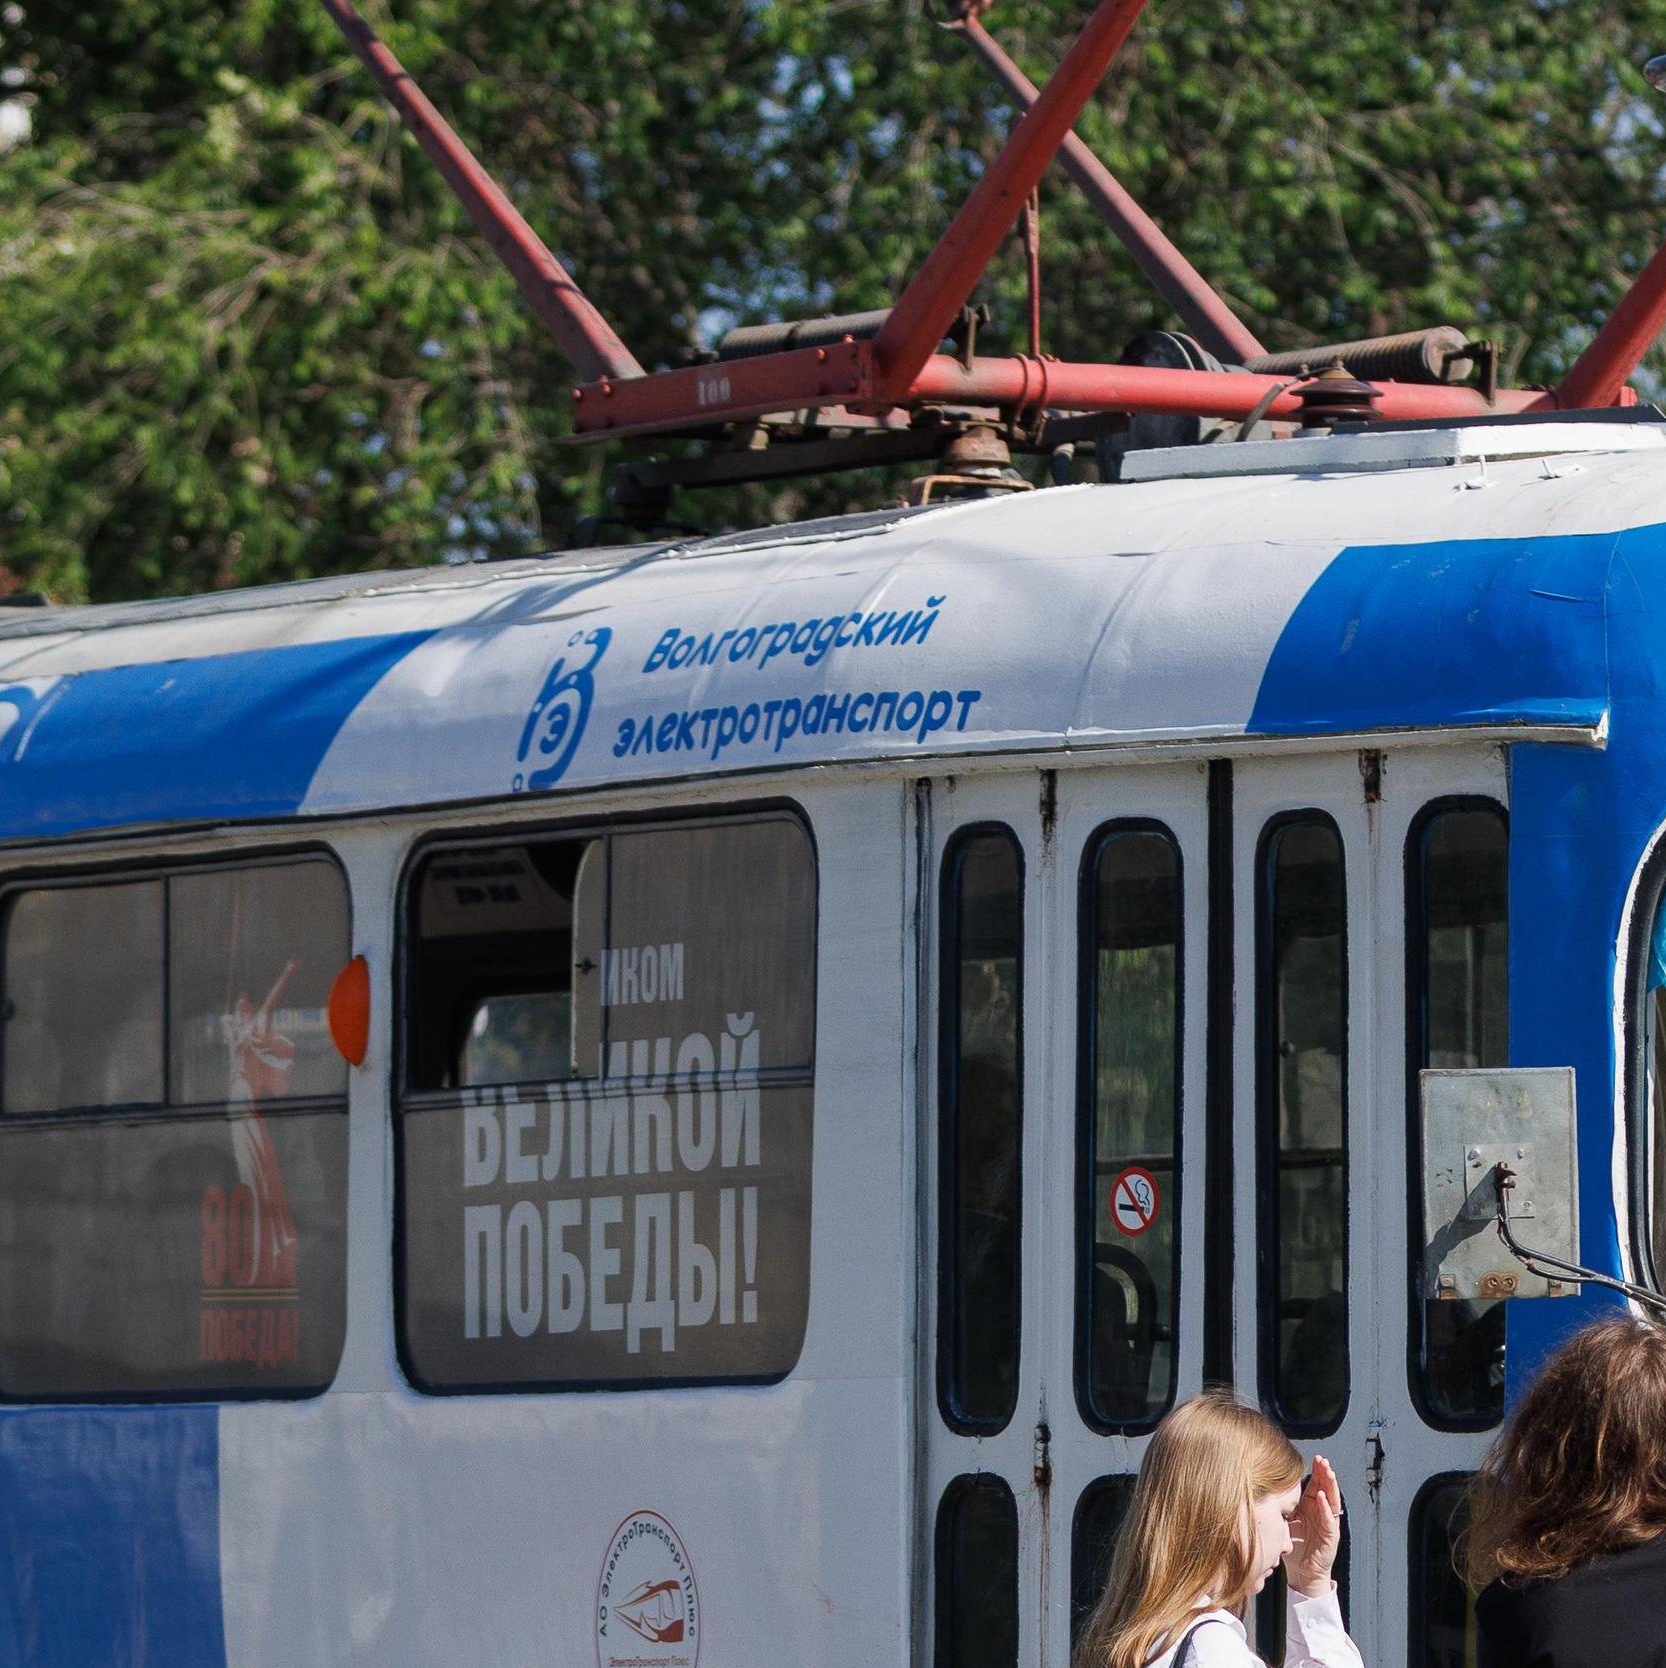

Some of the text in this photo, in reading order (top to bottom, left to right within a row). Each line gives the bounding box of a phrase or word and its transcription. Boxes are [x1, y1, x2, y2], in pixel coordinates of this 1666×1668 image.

[641, 594, 948, 675] Волгоградский
[612, 688, 983, 760] электротранспорт
[459, 1011, 762, 1188] ВЕЛИКОЙ
[463, 1186, 760, 1355] ПОБЕДЫ!
